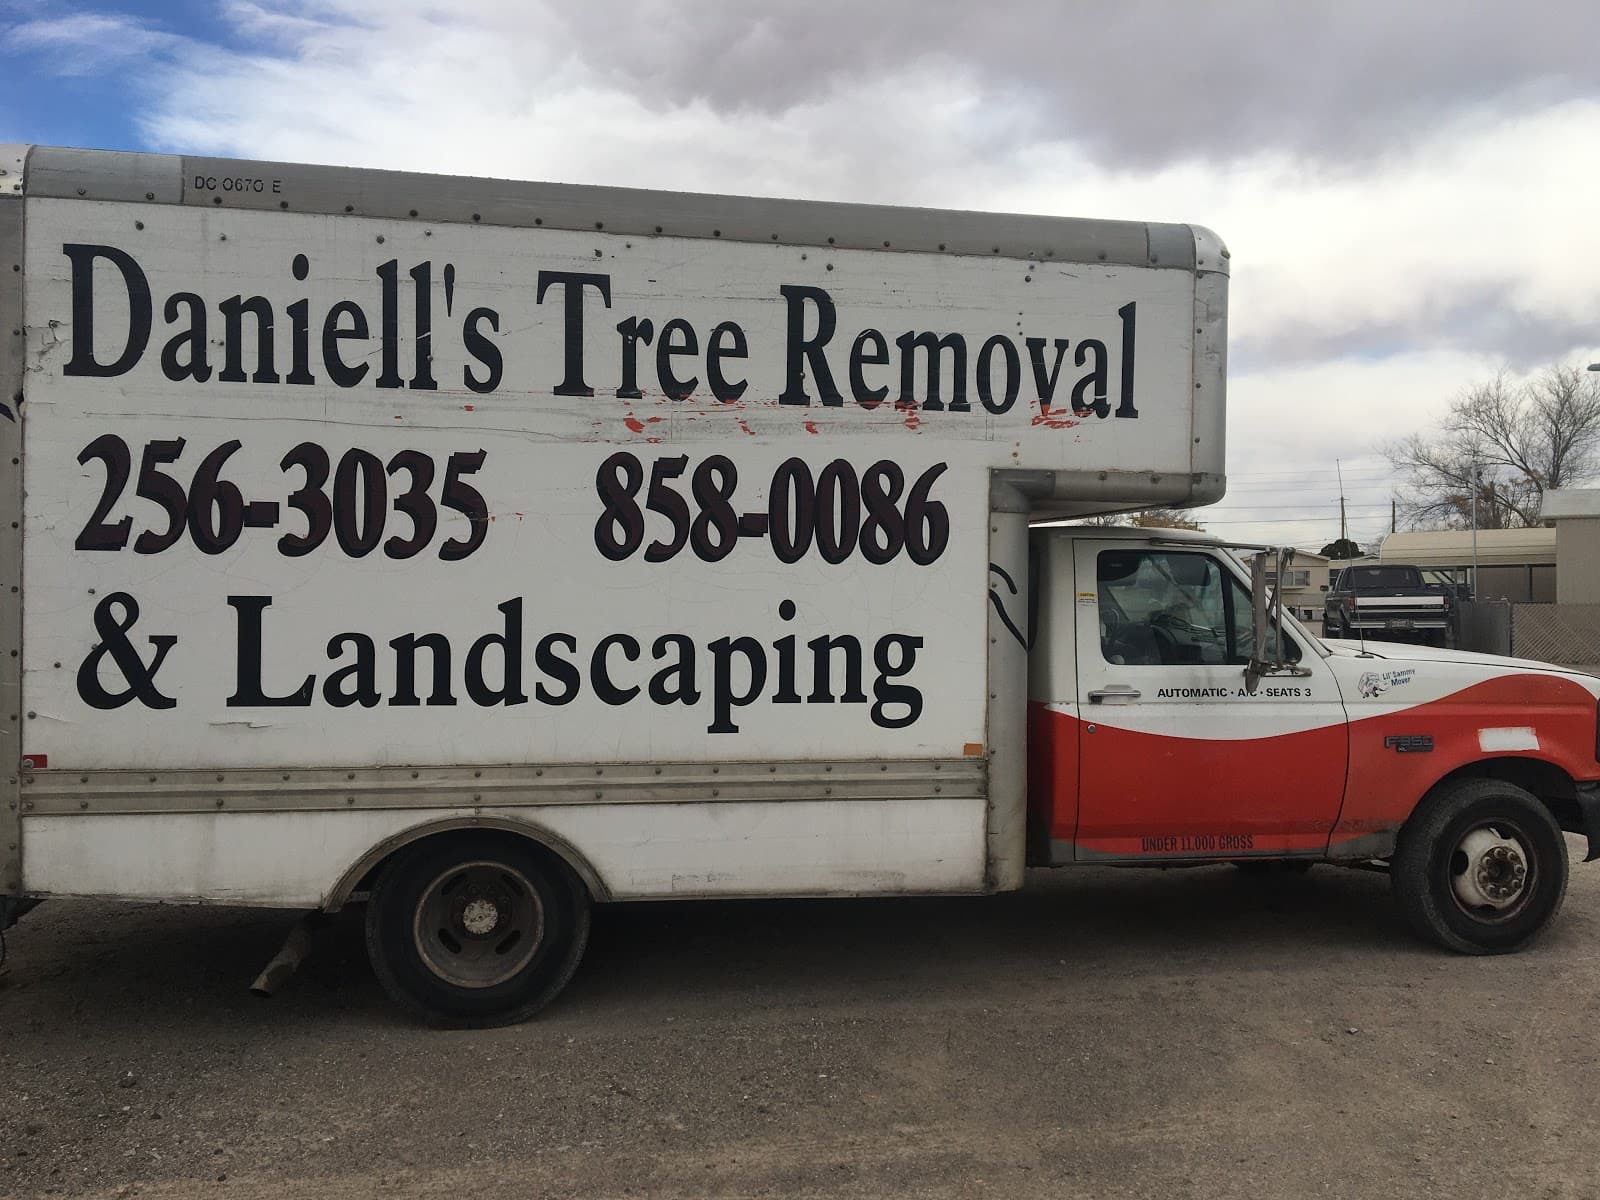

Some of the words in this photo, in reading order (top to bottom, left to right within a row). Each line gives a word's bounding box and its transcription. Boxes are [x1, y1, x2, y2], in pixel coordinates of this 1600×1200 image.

[194, 175, 217, 191] DC
[272, 180, 281, 194] E
[62, 243, 504, 394] Daniell's
[536, 270, 749, 405] Tree
[778, 284, 1139, 420] Removal
[75, 433, 490, 562] 256-3035
[594, 451, 950, 567] 858-0086
[76, 591, 178, 710] &
[226, 595, 924, 734] Landscaping
[1391, 678, 1410, 686] Mover
[1157, 688, 1228, 698] AUTOMATIC
[1266, 688, 1301, 697] SEATS
[1304, 688, 1312, 697] 3
[1142, 837, 1177, 852] UNDER
[1218, 834, 1254, 849] GROSS
